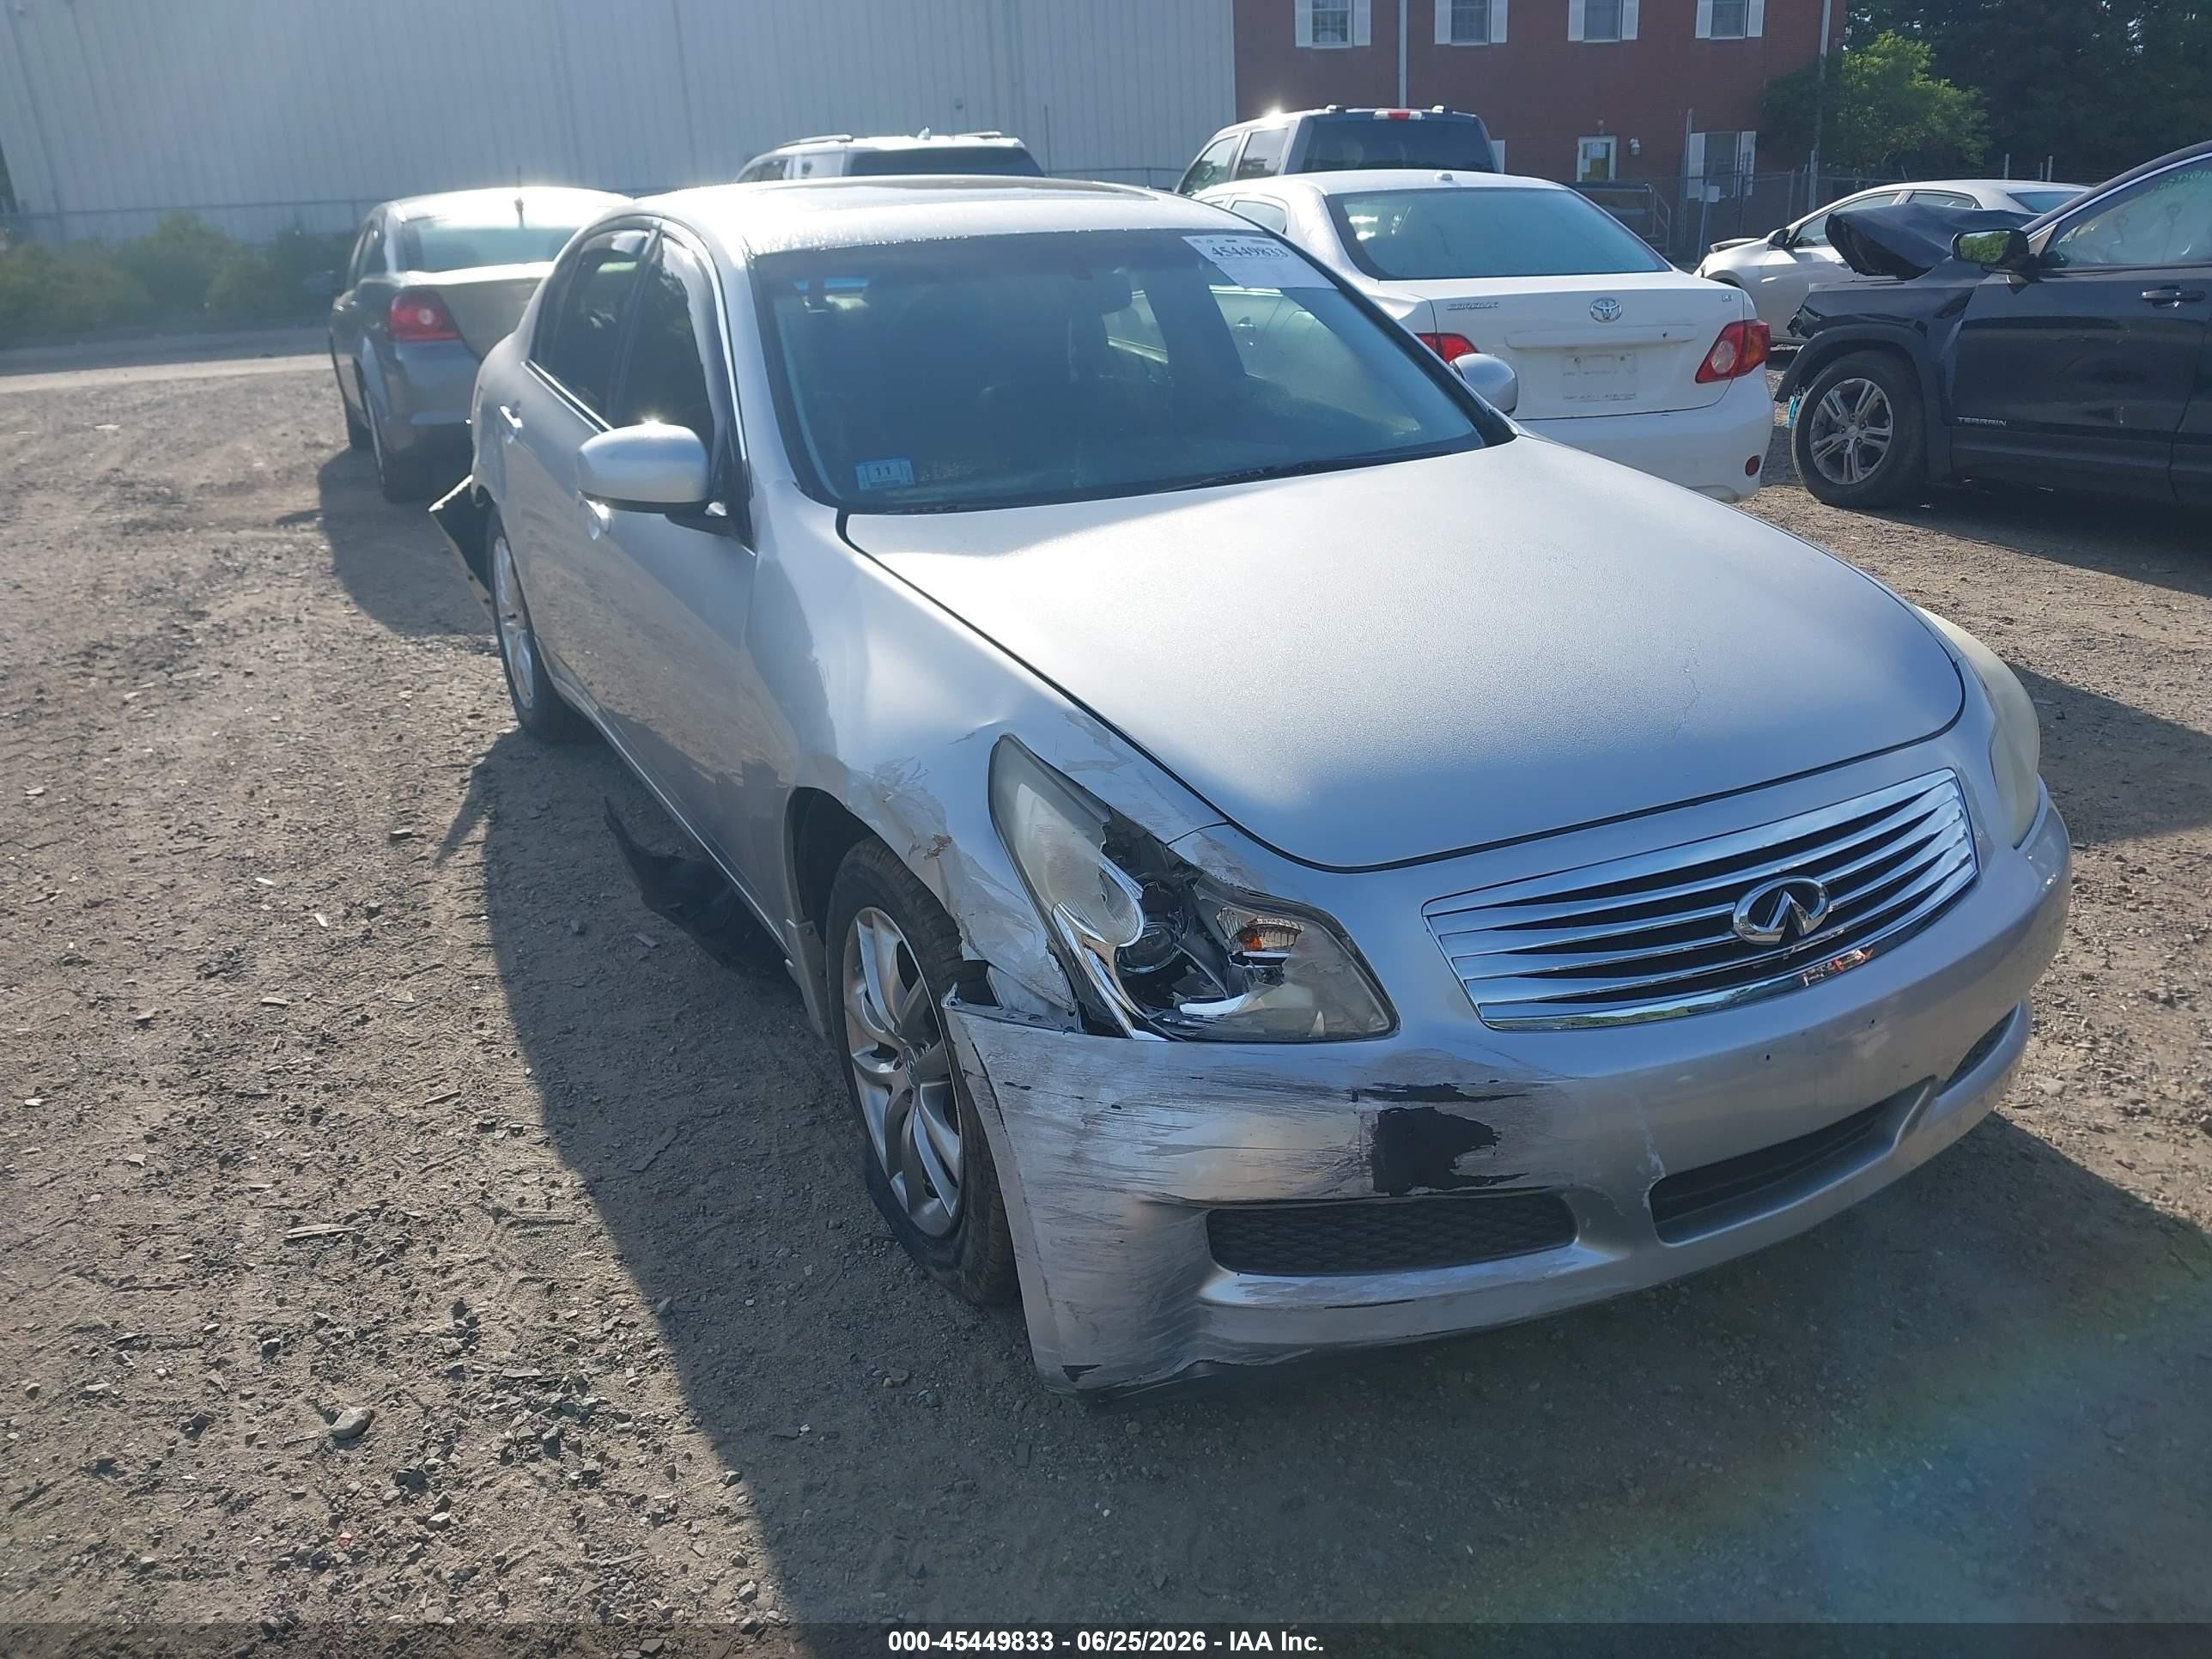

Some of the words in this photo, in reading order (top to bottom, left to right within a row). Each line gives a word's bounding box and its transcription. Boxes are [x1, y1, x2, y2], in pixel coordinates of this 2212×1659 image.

[1212, 246, 1289, 258] 45449833
[1958, 416, 2007, 427] TERRAIN
[876, 466, 891, 477] 11
